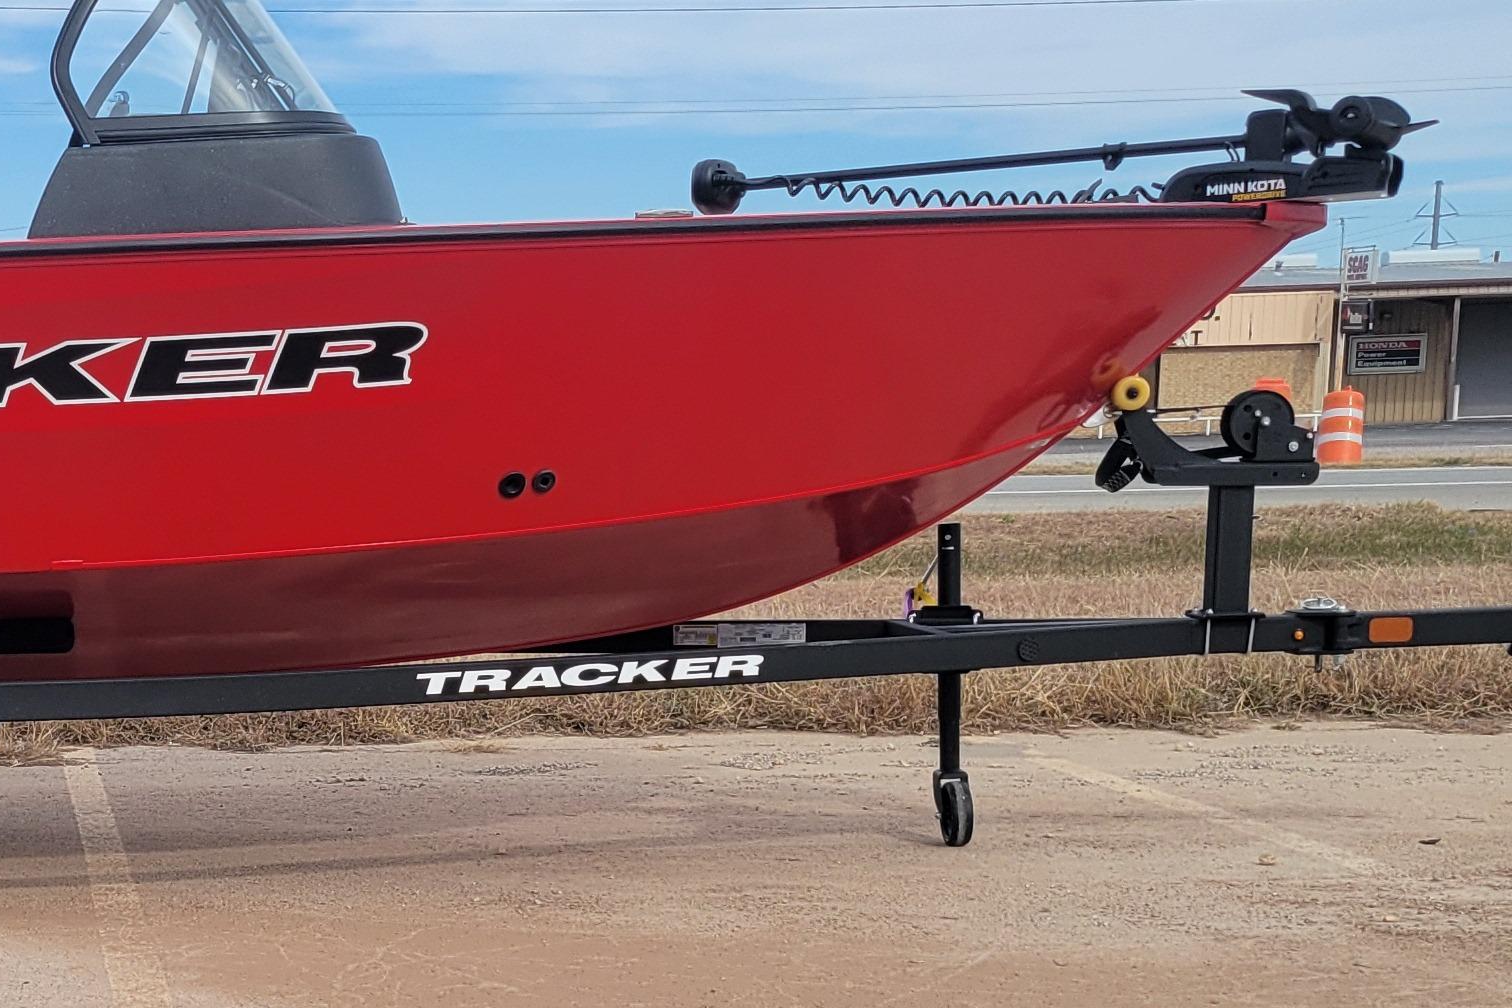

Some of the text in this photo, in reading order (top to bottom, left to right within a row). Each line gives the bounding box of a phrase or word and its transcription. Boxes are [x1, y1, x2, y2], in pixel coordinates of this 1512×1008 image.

[1206, 178, 1287, 197] MINN KOTA
[1348, 254, 1369, 274] SCAG
[1357, 342, 1408, 351] HONDA
[416, 654, 764, 695] TRACKER
